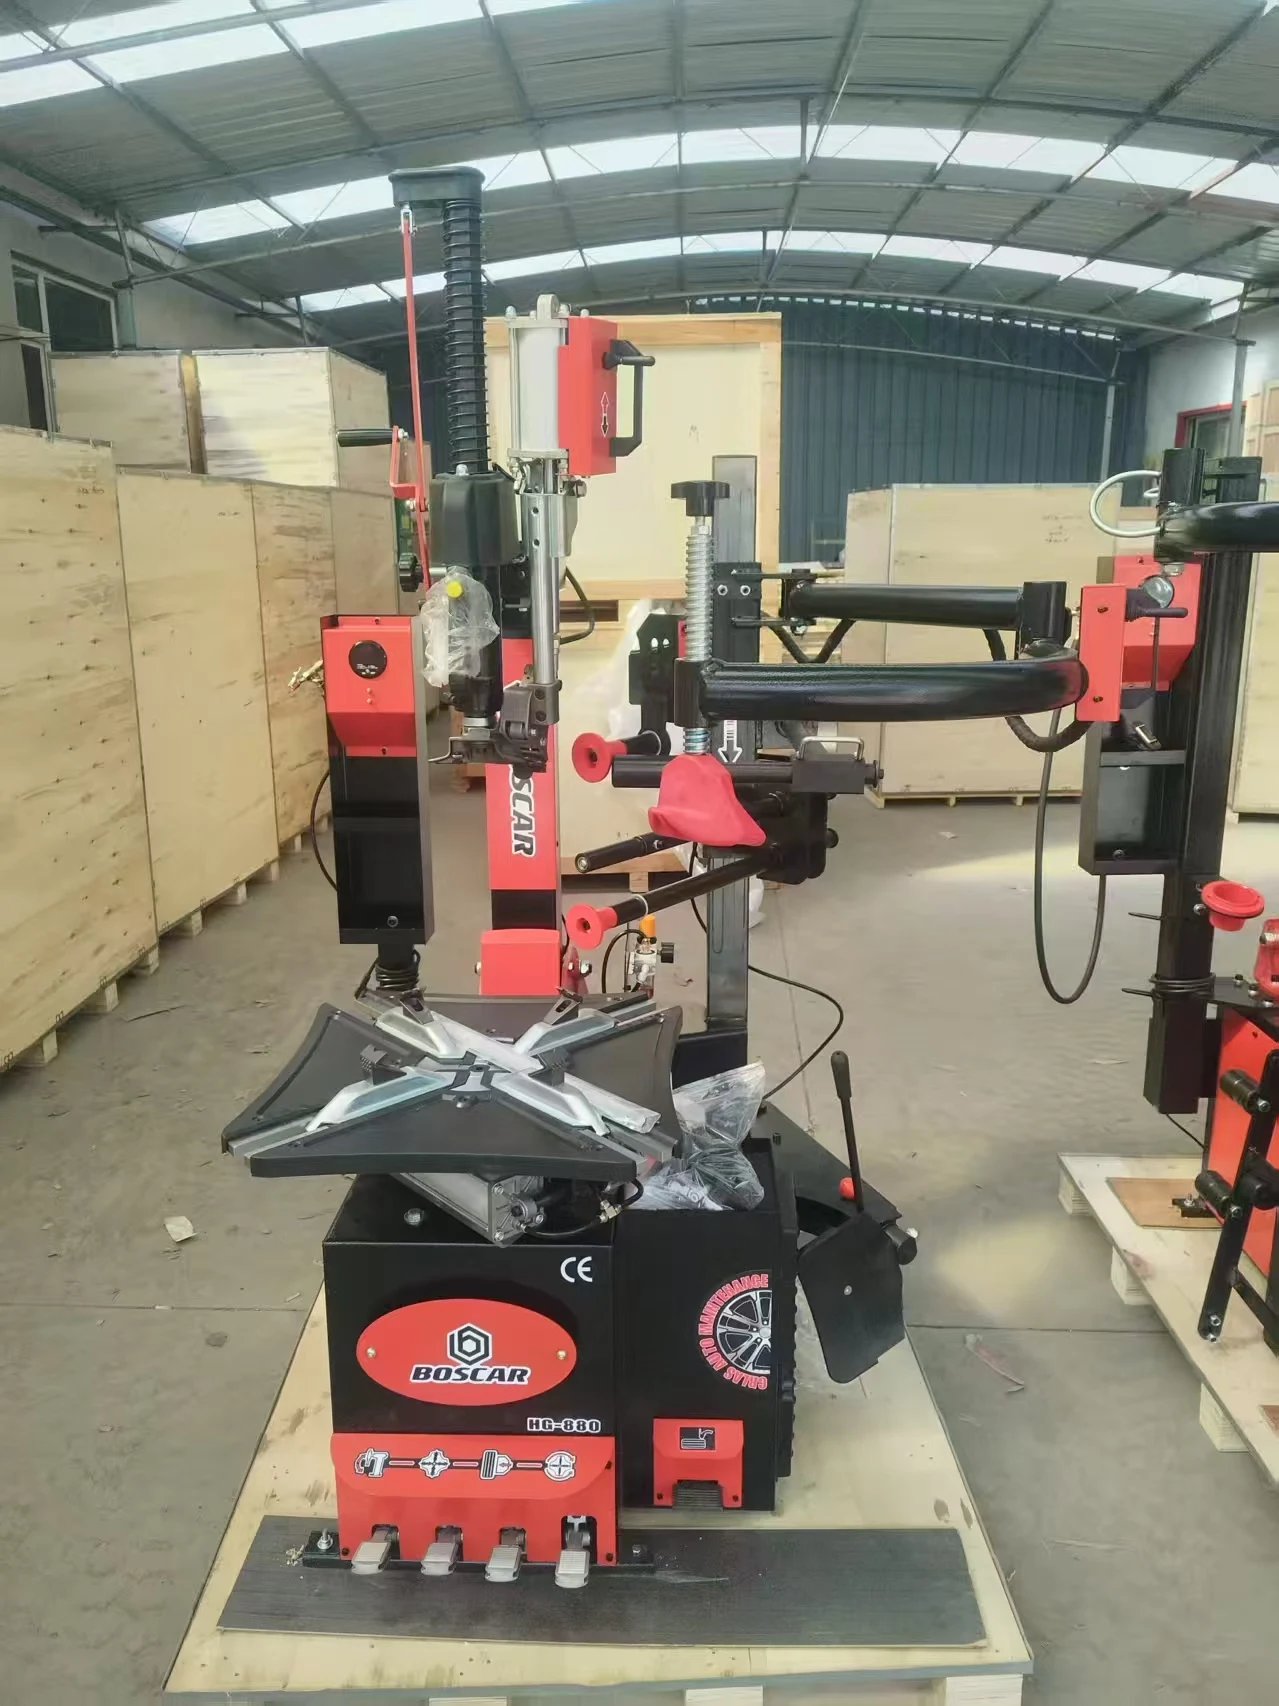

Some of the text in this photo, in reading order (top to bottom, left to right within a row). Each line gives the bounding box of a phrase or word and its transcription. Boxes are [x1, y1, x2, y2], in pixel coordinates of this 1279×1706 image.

[509, 768, 536, 858] SCAR
[560, 1256, 593, 1283] CE
[698, 1273, 769, 1336] MAINTENANCE
[699, 1337, 729, 1372] AUTO
[409, 1364, 531, 1385] BOSCAR
[527, 1418, 601, 1433] HG-880
